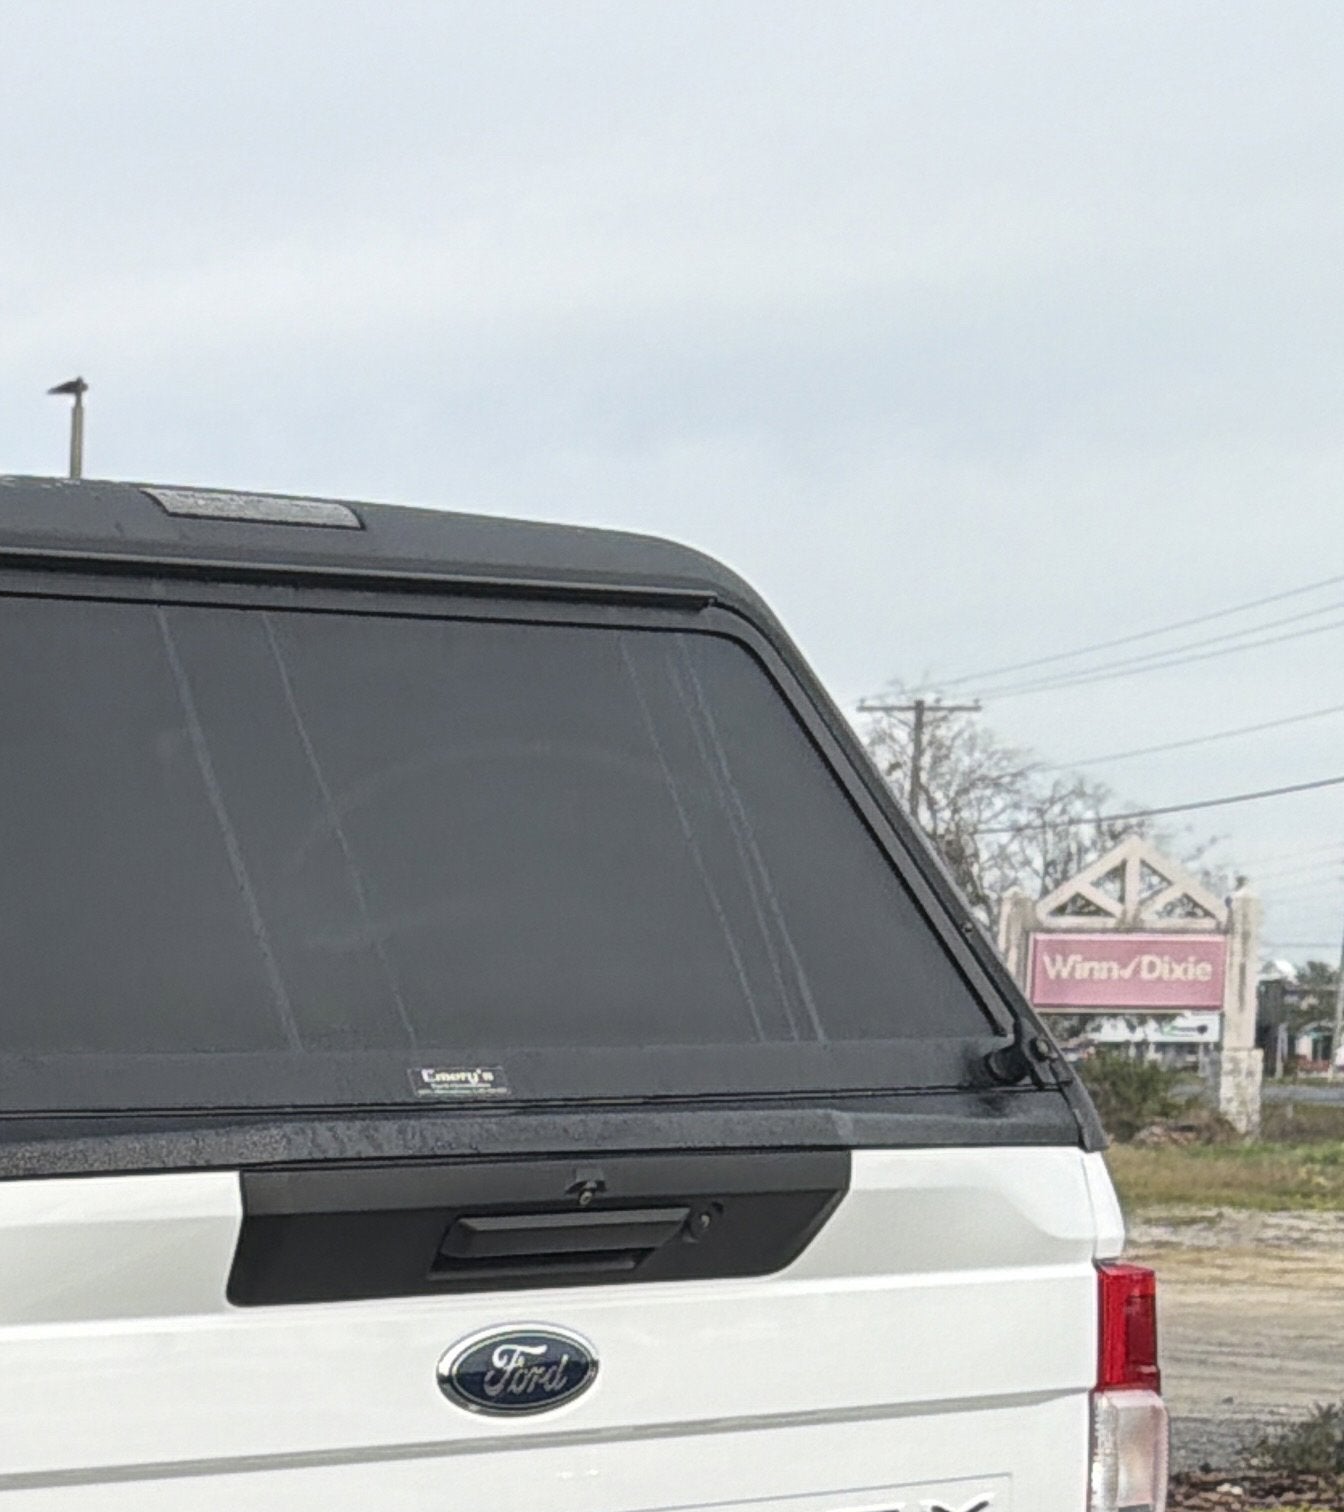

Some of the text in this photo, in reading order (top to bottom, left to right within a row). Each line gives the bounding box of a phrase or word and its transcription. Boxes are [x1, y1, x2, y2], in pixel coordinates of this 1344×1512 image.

[1042, 954, 1212, 982] Winn Dixie
[483, 1343, 569, 1396] Ford
